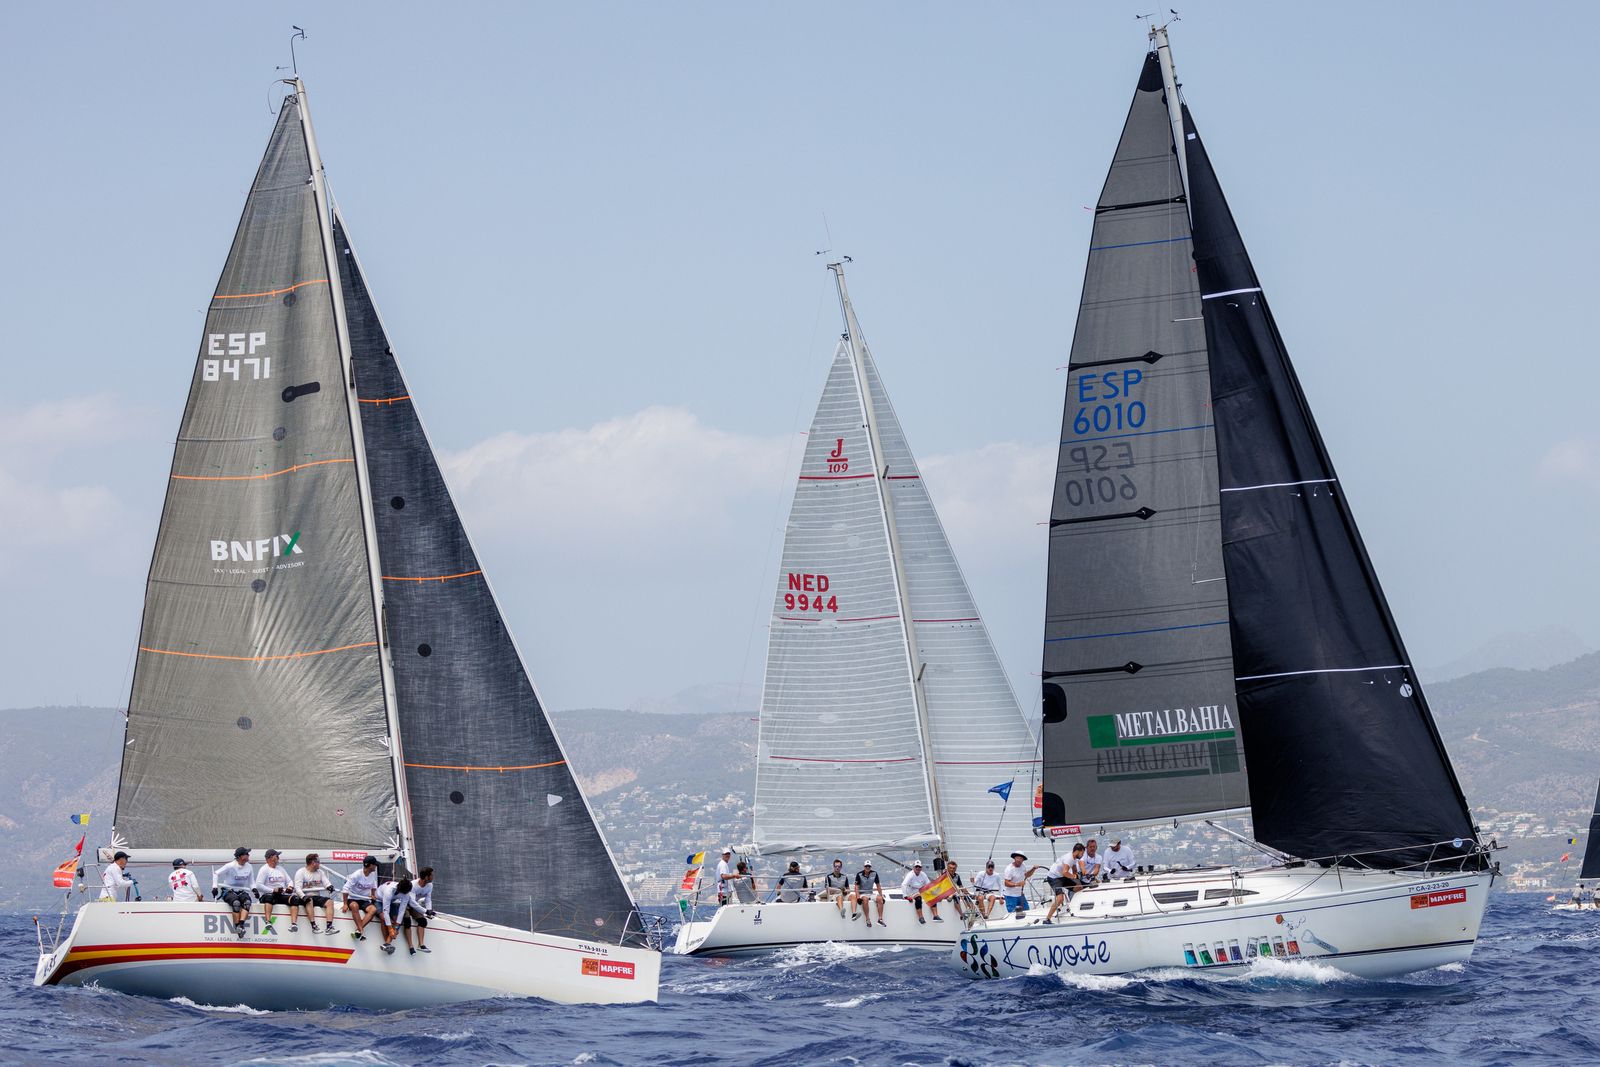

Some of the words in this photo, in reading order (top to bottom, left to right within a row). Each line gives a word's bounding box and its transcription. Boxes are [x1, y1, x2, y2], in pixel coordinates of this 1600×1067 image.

[208, 331, 267, 356] ESP
[202, 356, 271, 382] 8471
[1079, 369, 1143, 403] ESP
[1073, 400, 1146, 435] 6010
[830, 438, 844, 458] J
[827, 462, 849, 474] 109
[210, 531, 304, 562] BNFIX
[788, 572, 830, 593] NED
[784, 593, 839, 613] 9944
[1116, 704, 1235, 738] METALBAHIA
[1430, 893, 1464, 903] MAPFRE
[601, 965, 633, 975] MAPFRE
